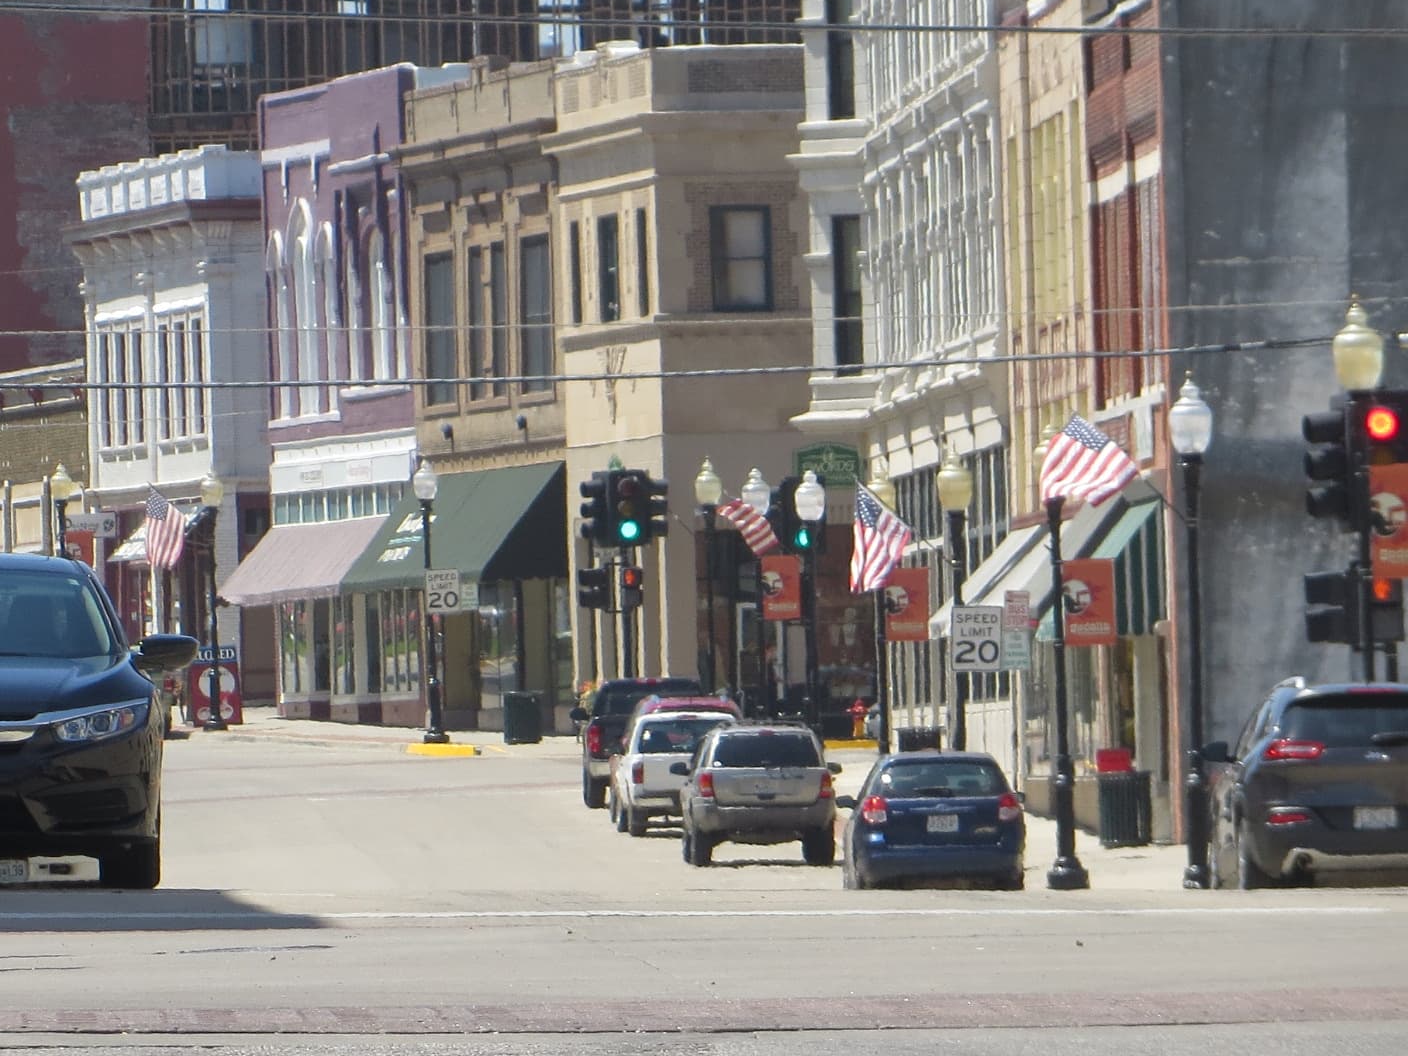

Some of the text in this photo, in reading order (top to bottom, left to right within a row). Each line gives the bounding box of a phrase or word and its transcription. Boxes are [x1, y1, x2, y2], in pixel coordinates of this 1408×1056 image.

[427, 573, 457, 582] SPEED
[431, 582, 453, 591] LIMIT
[428, 591, 459, 609] 20
[956, 613, 998, 624] SPEED
[960, 627, 993, 637] LIMIT
[954, 639, 1000, 664] 20
